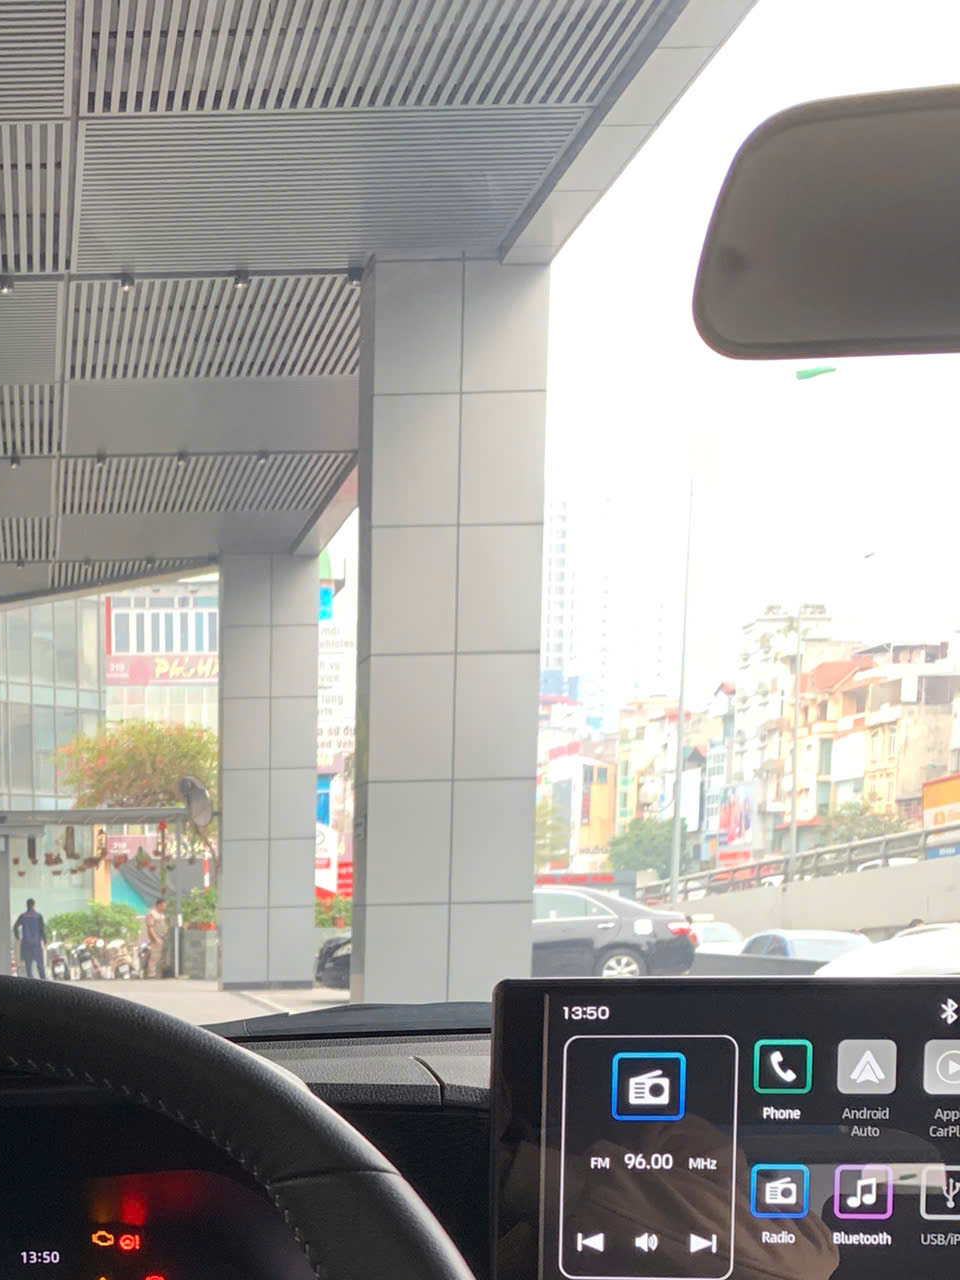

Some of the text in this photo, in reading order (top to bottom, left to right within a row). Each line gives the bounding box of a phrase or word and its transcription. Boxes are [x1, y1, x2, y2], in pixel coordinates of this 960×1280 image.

[561, 1005, 611, 1021] 13:50
[761, 1105, 802, 1121] Phone
[841, 1105, 890, 1121] Android
[850, 1124, 881, 1138] Auto
[590, 1152, 718, 1171] FM 96.00 MHz
[761, 1229, 797, 1245] Radio
[832, 1230, 892, 1247] Bluetooth
[19, 1249, 61, 1265] 13:50
